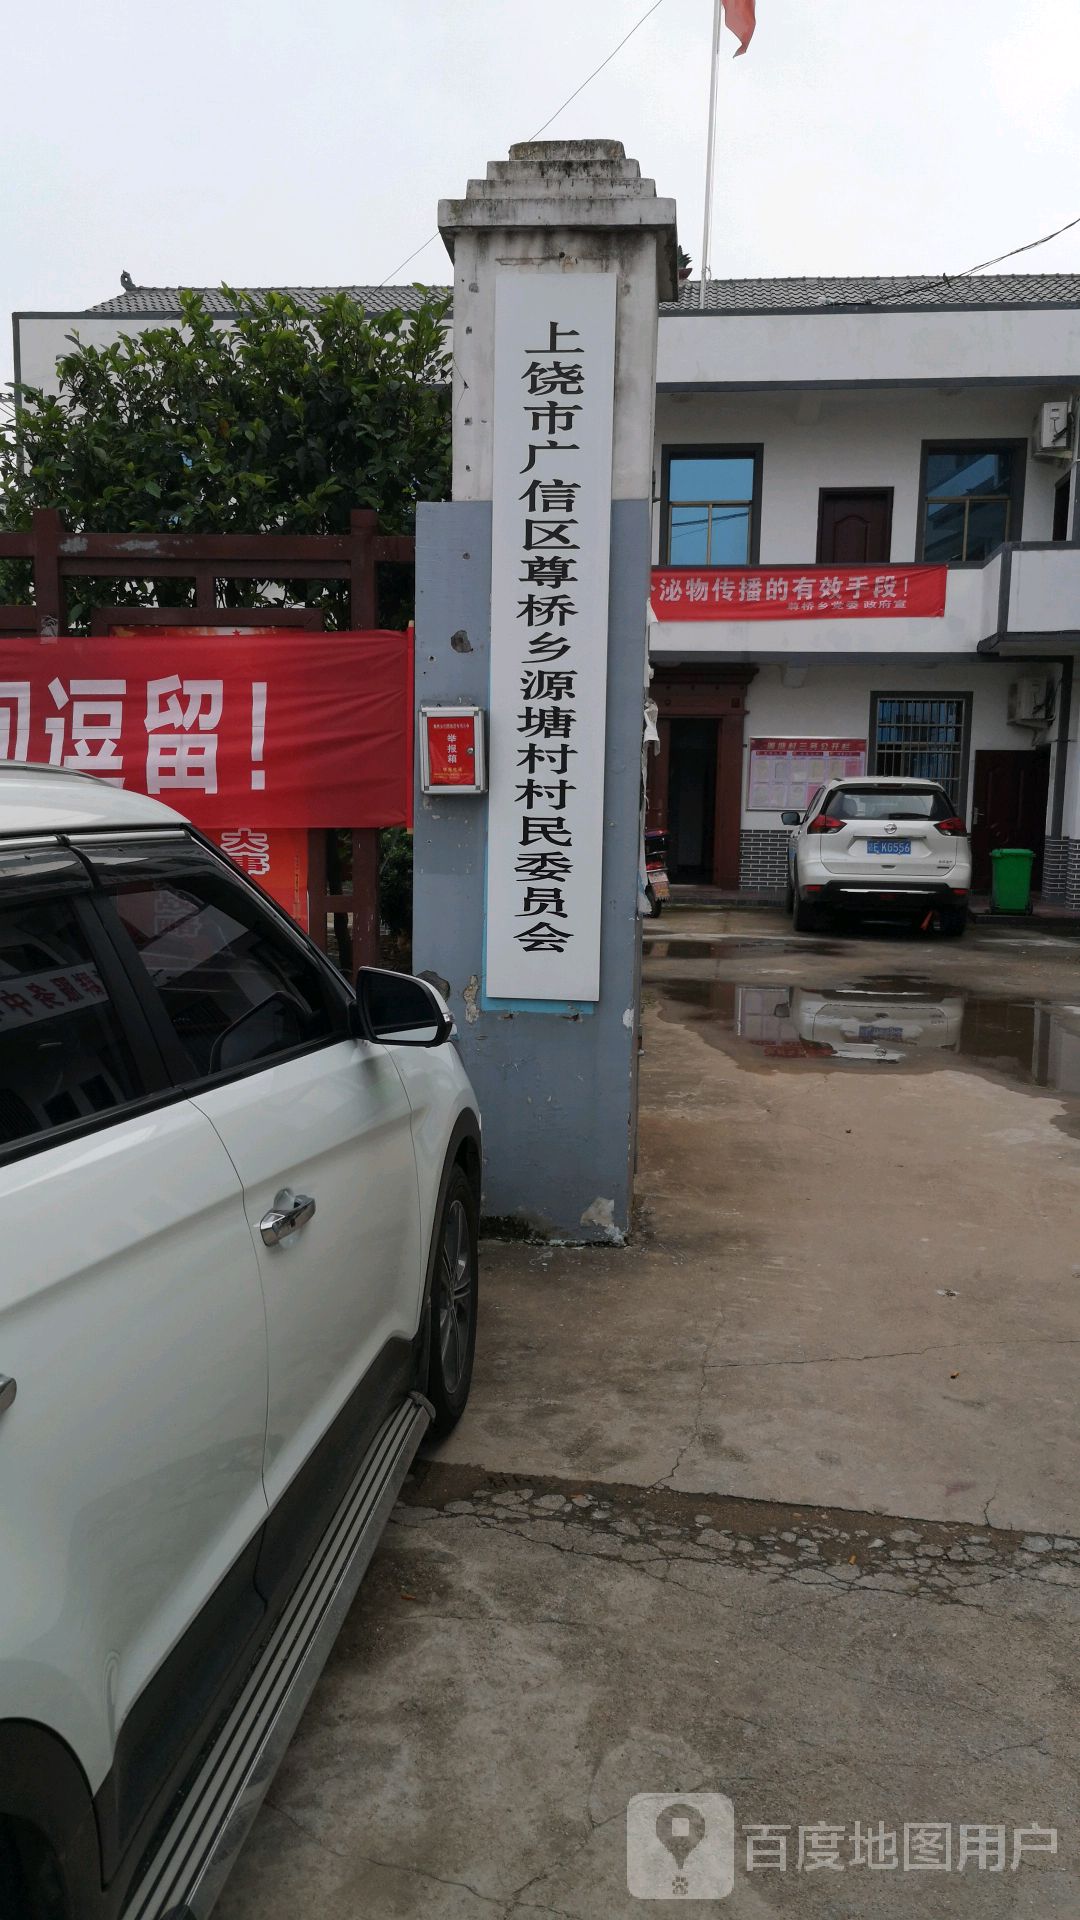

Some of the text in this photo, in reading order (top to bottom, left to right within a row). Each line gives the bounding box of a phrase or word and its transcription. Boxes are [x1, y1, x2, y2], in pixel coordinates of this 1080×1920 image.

[650, 575, 909, 602] 泌物传播的有效手段！
[513, 320, 585, 954] 上饶市广信区尊桥乡源塘村村民委员会
[447, 733, 457, 764] 举报箱
